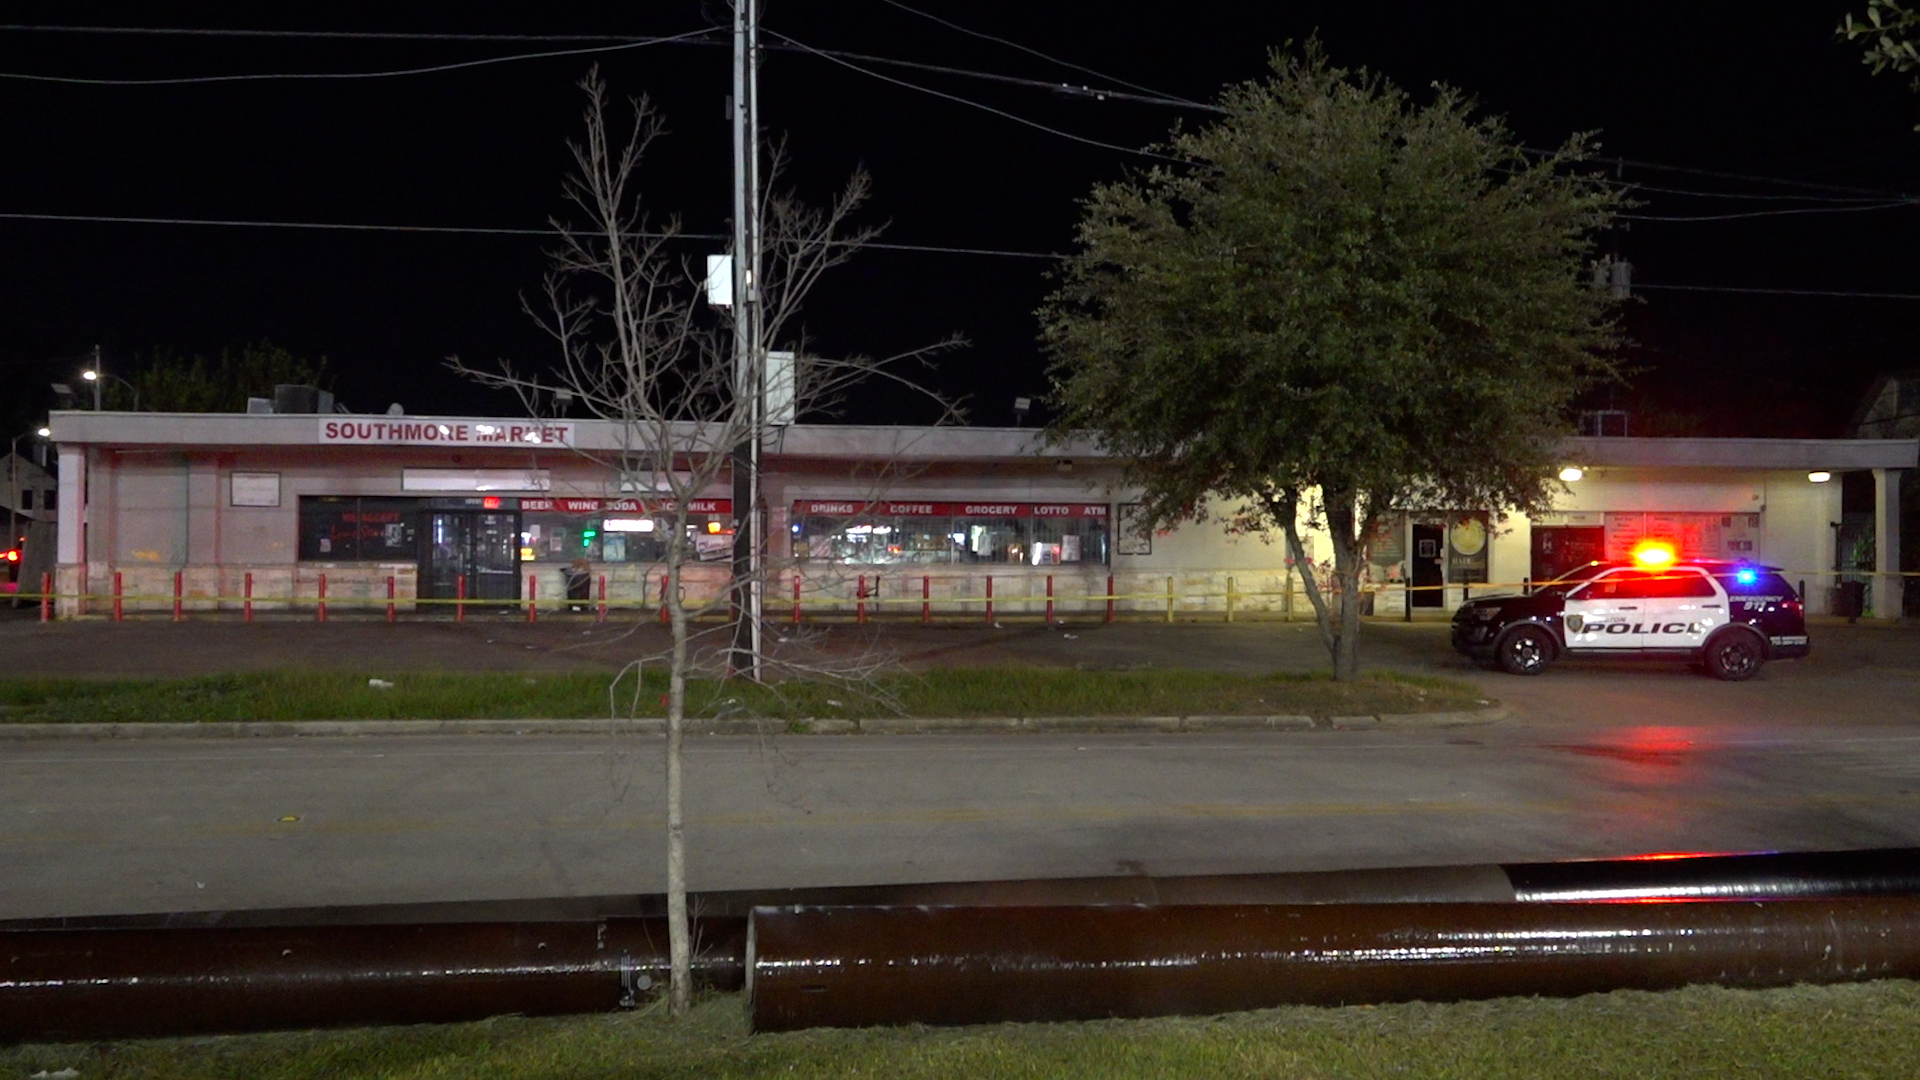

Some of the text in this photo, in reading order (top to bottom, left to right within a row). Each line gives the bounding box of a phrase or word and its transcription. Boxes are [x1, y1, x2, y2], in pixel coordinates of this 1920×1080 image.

[325, 422, 469, 441] SOUTHMORE
[521, 501, 553, 510] BEER
[568, 501, 599, 510] WINE
[605, 502, 637, 511] SODA
[687, 502, 716, 511] MILK
[811, 504, 1107, 516] DRINKS COFFEE GROCERY LOTTO ATM
[1743, 601, 1767, 611] 911
[1581, 622, 1704, 635] POLICE
